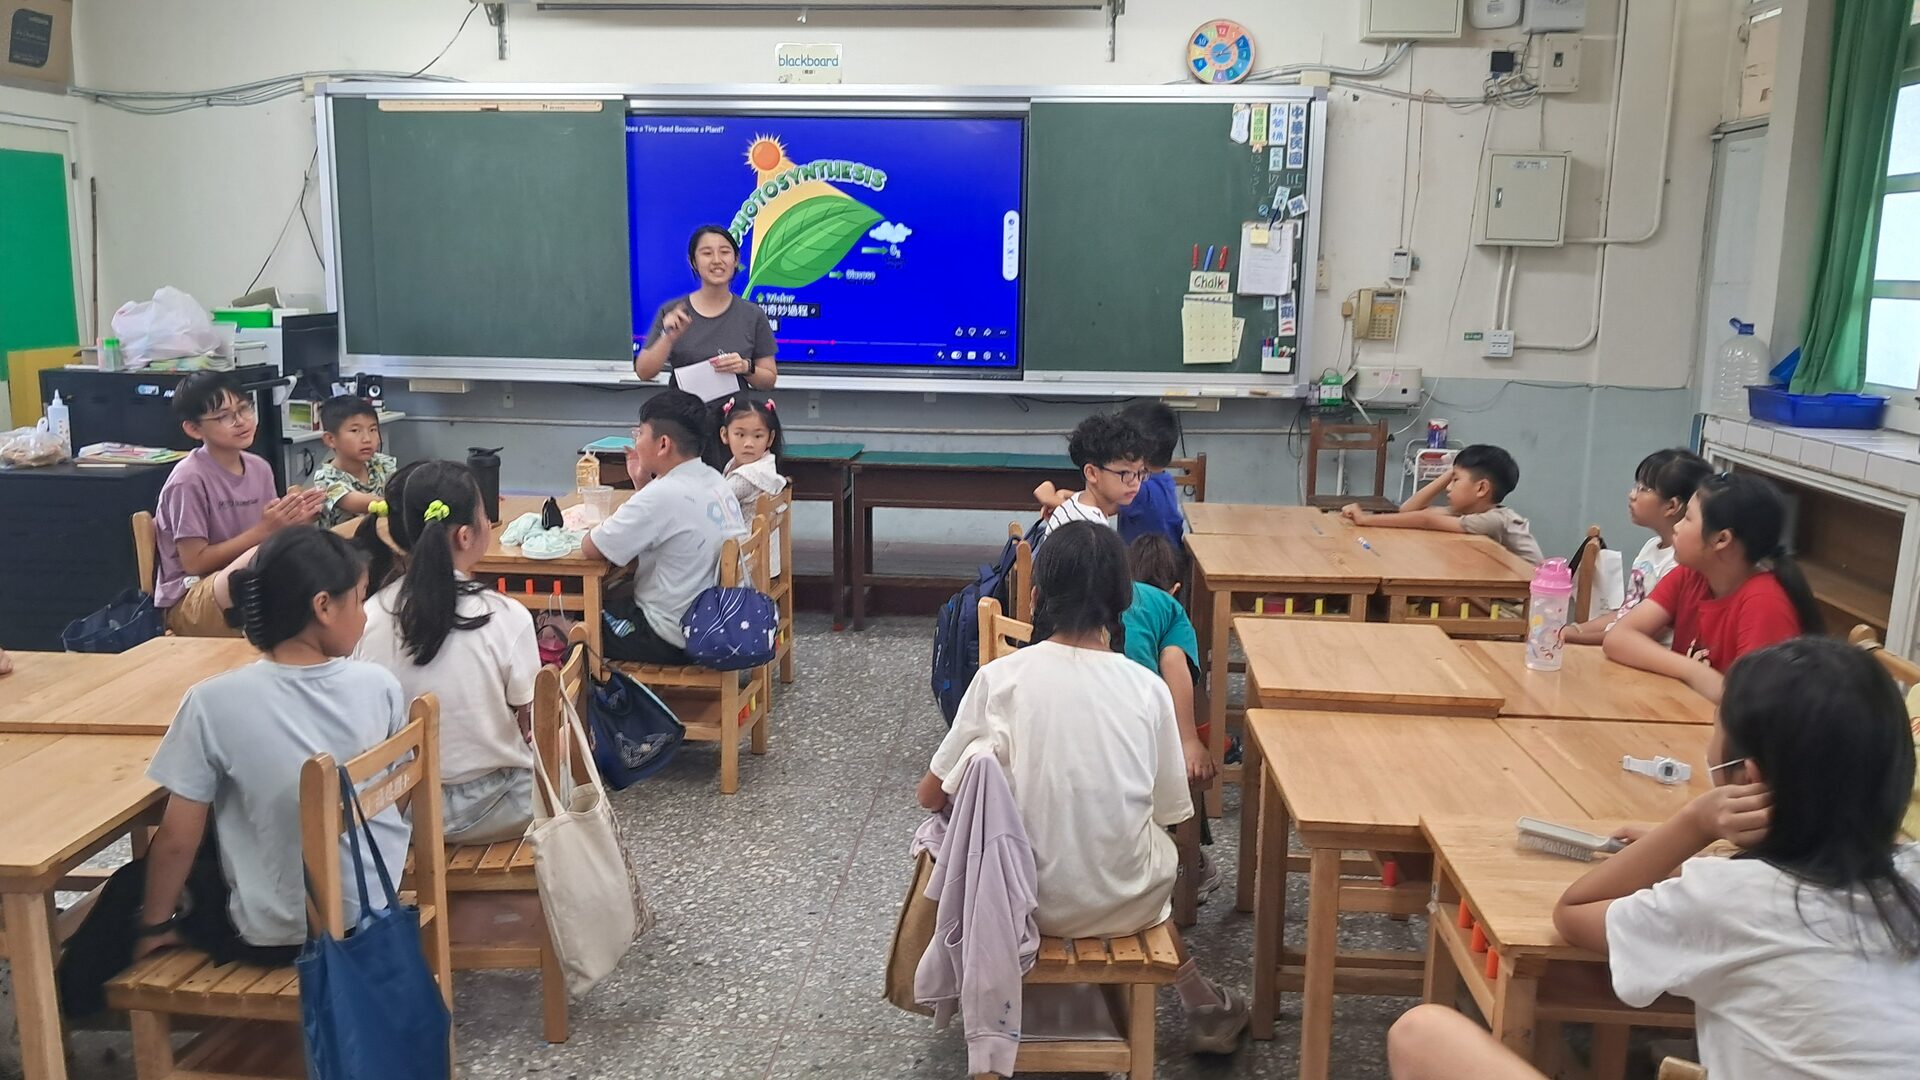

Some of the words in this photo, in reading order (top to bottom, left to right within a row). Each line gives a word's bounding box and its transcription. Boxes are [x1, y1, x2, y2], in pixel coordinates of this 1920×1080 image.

[778, 54, 839, 67] blackboard
[644, 125, 657, 134] Tiny
[675, 125, 699, 133] Become
[705, 125, 724, 133] Plant?
[728, 159, 887, 247] PHOTOSYNTHESIS
[1194, 275, 1224, 289] Chalk
